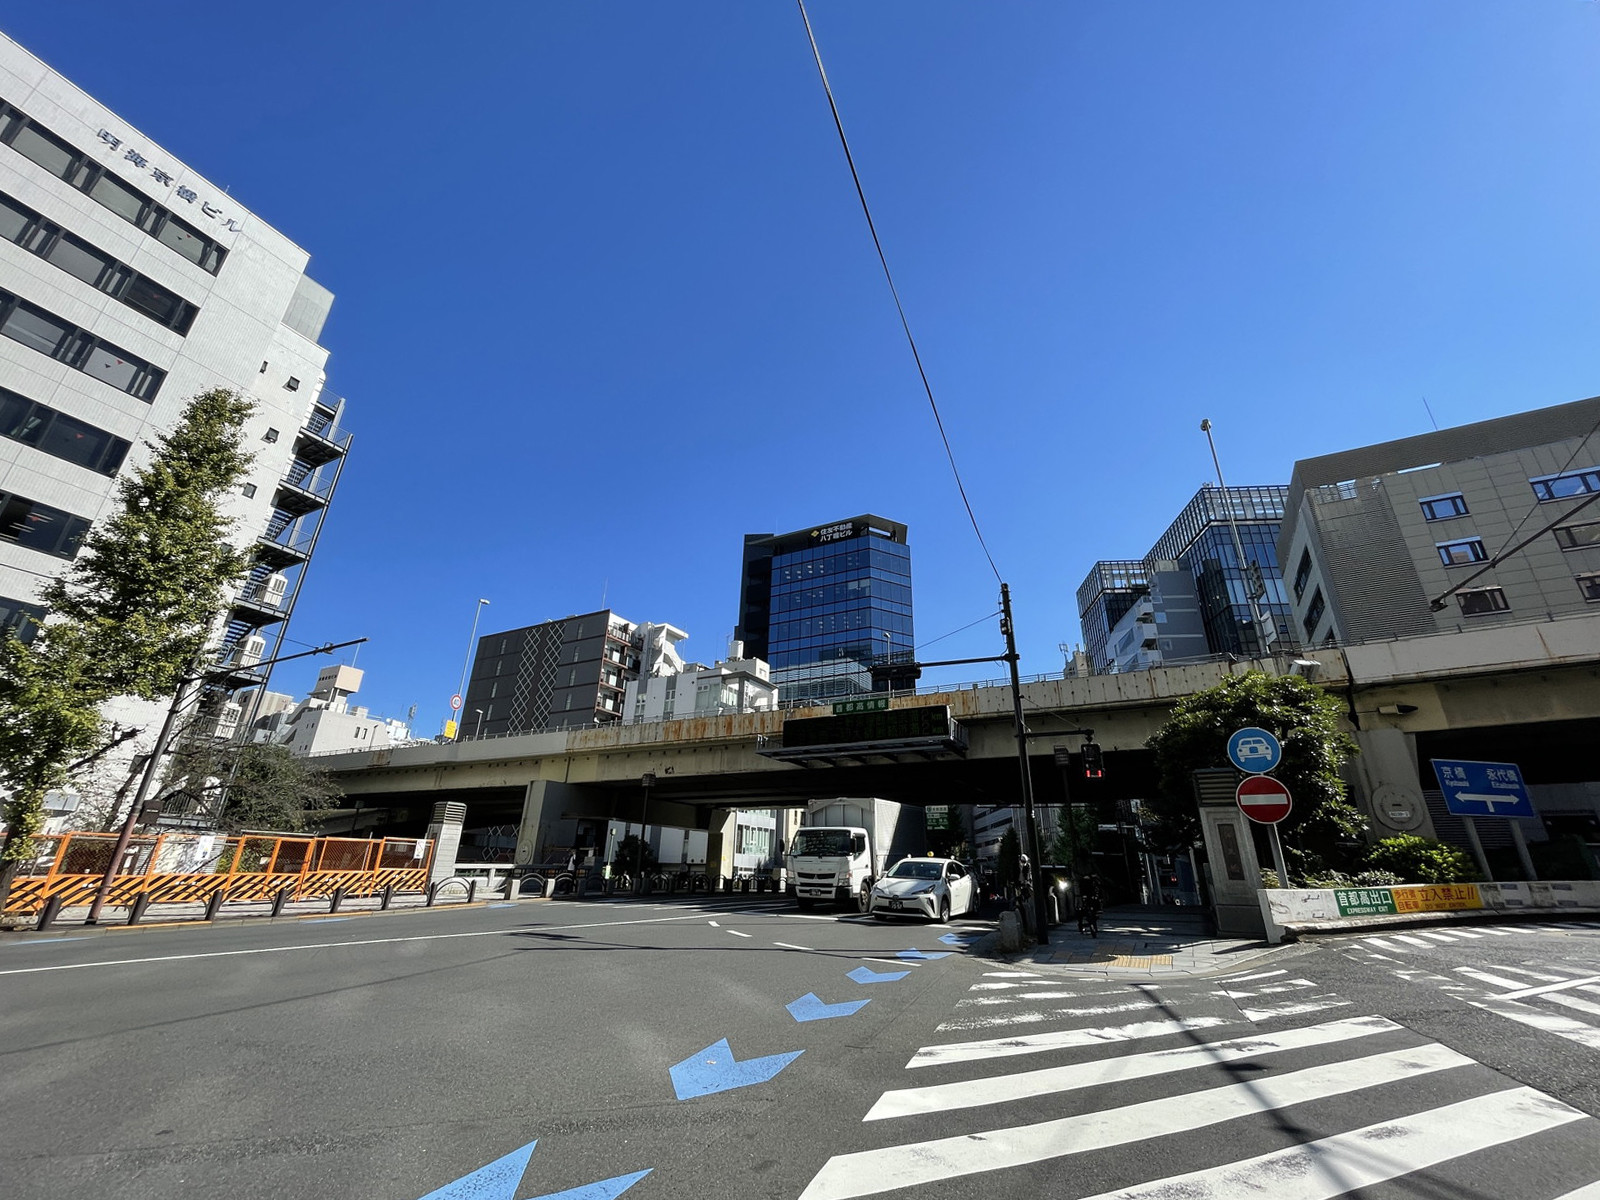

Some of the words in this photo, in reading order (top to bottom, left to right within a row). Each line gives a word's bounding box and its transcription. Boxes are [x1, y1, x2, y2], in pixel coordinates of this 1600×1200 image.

[97, 128, 243, 233] 明海京橋ビル
[820, 522, 853, 536] 住友不動産
[1441, 767, 1466, 779] 京橋
[1486, 768, 1519, 782] 永代橋
[1337, 890, 1392, 906] 首都高出口
[1394, 889, 1417, 899] 歩行者
